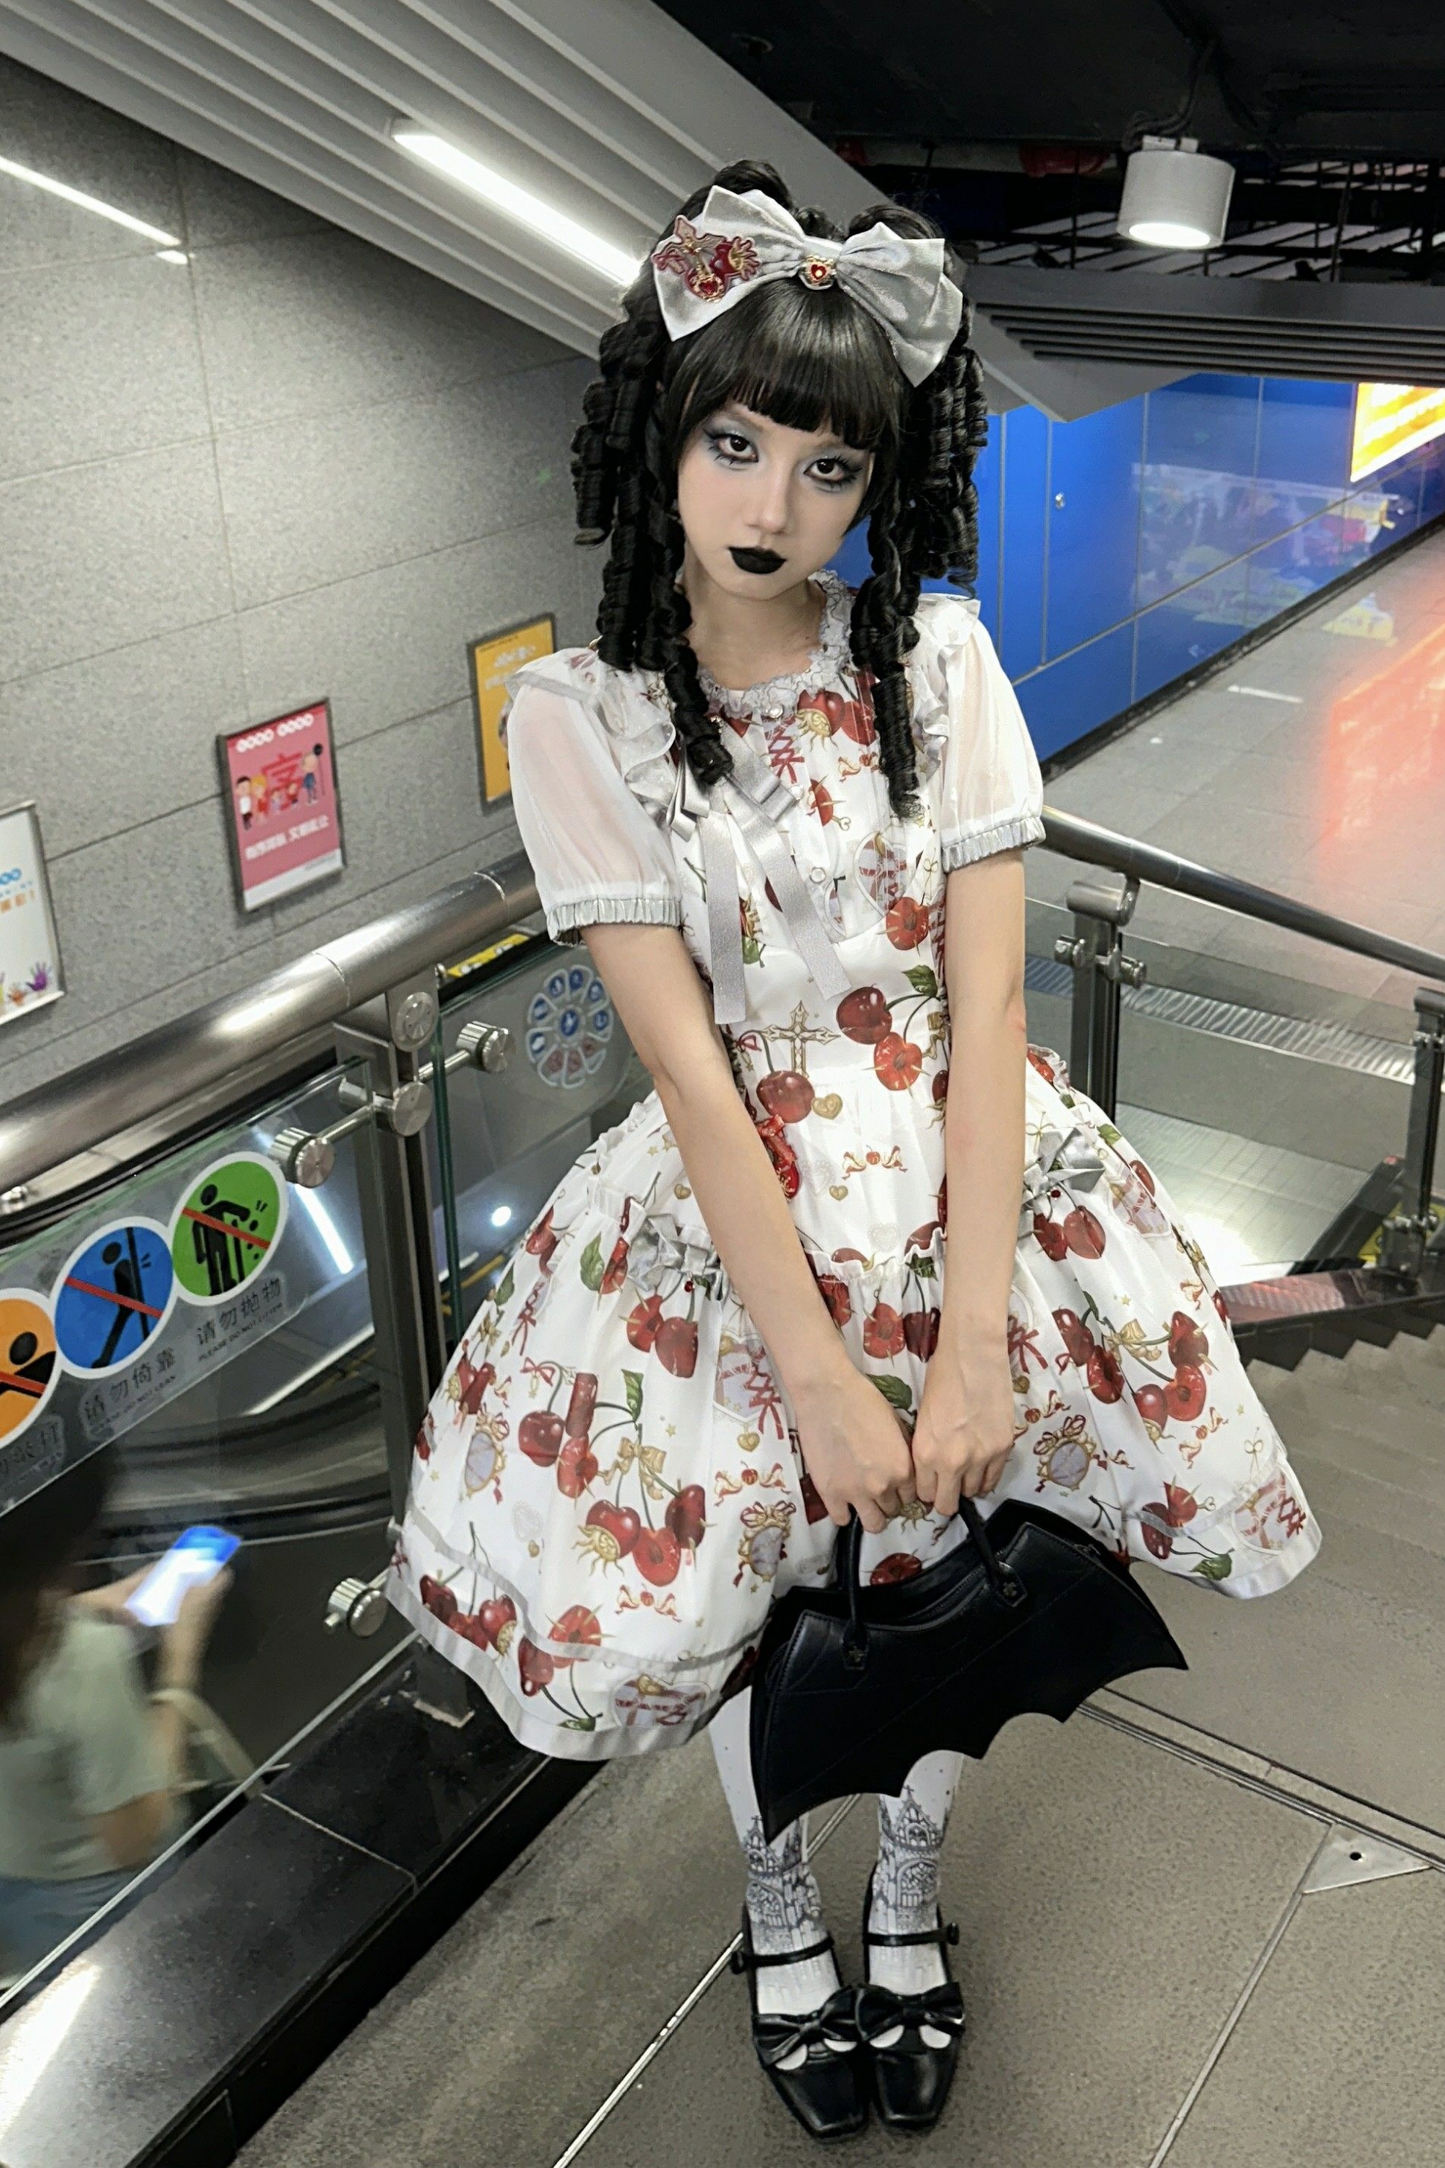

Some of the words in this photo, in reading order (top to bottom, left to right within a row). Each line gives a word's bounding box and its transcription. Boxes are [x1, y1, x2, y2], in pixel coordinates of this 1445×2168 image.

[197, 1277, 281, 1345] 请勿抛物
[84, 1347, 175, 1421] 请勿倚靠
[198, 1339, 227, 1362] PLEASE
